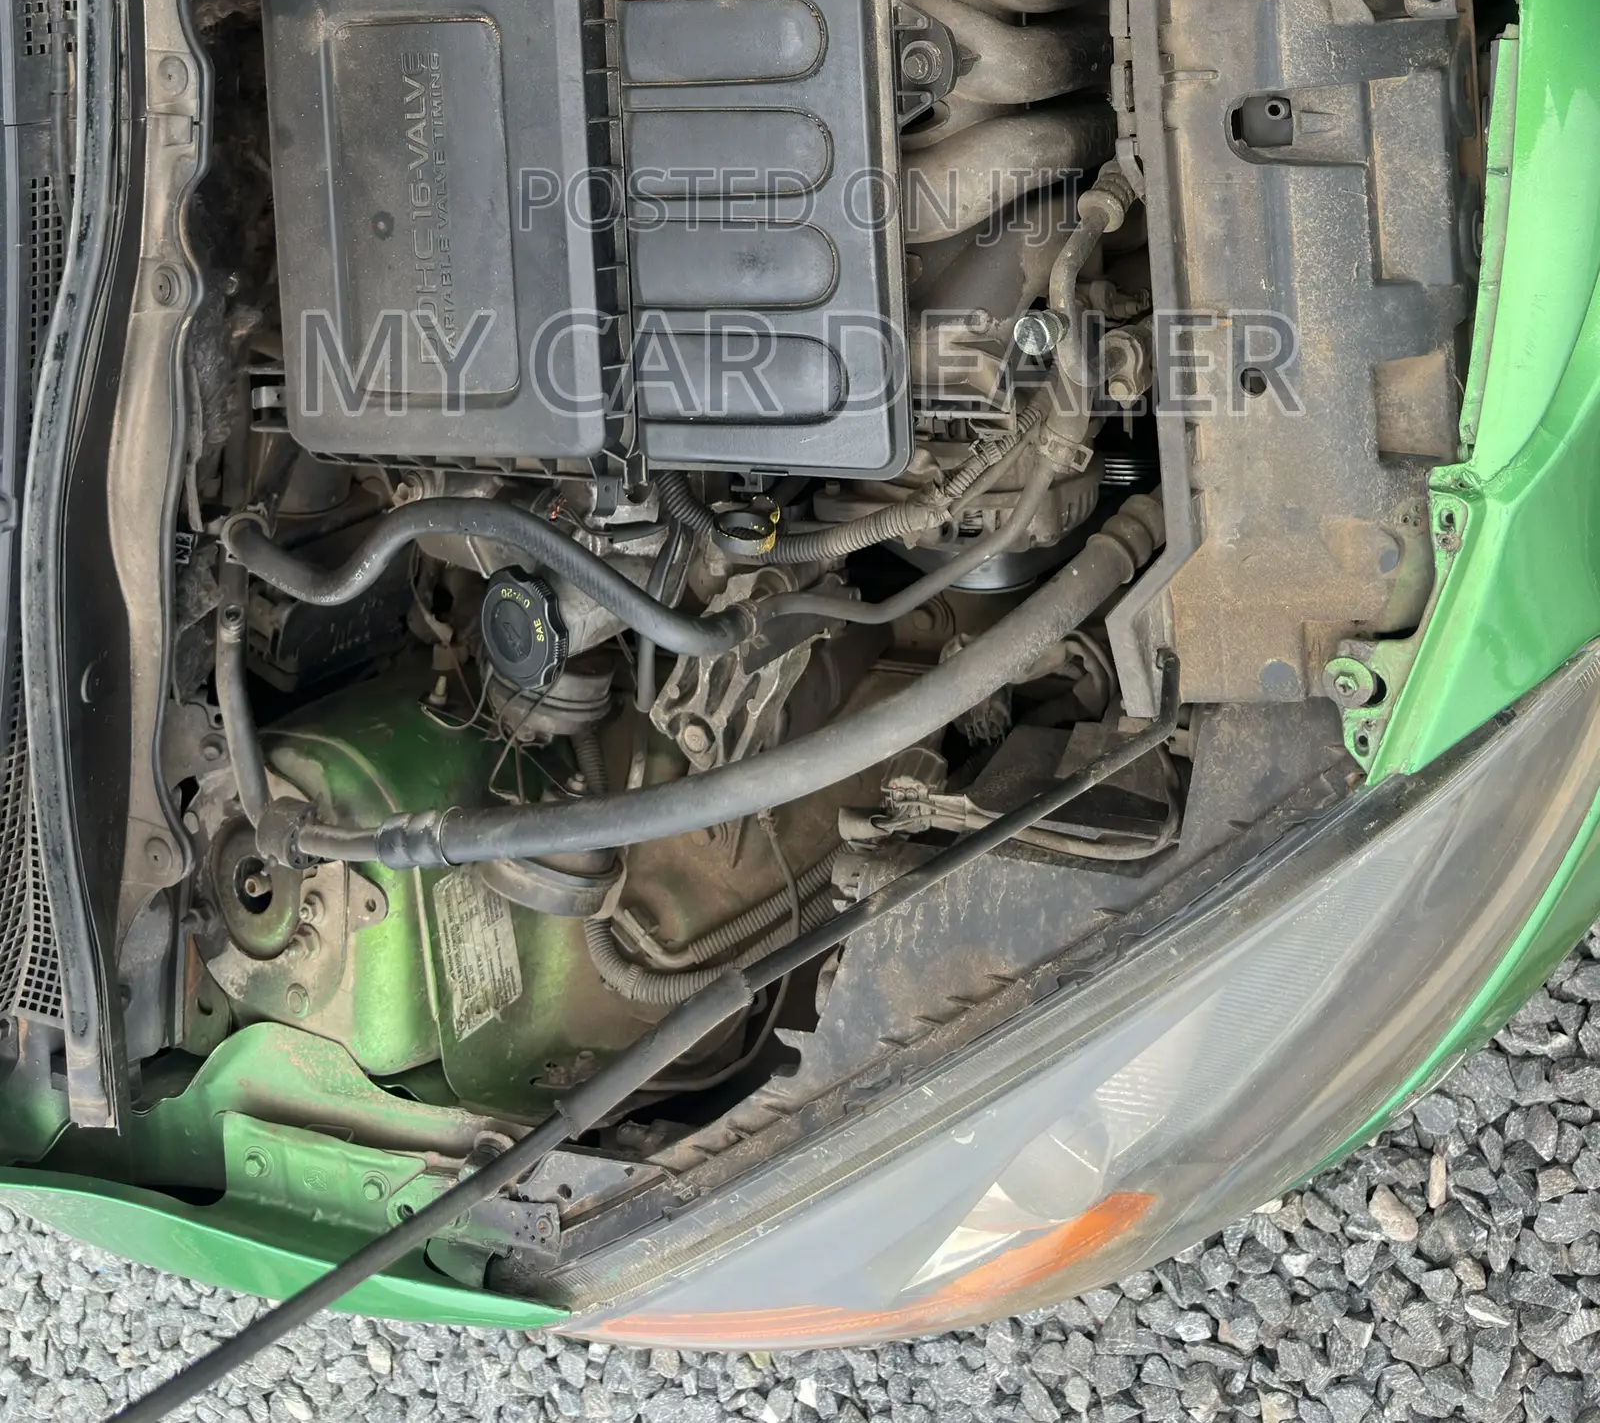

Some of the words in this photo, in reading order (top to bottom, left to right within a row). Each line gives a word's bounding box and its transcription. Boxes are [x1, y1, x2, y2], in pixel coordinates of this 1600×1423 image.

[402, 52, 433, 222] 16-VALVE
[429, 52, 444, 145] TIMING
[432, 149, 449, 227] VALVE
[413, 228, 440, 365] DOHC
[533, 618, 545, 642] SAE
